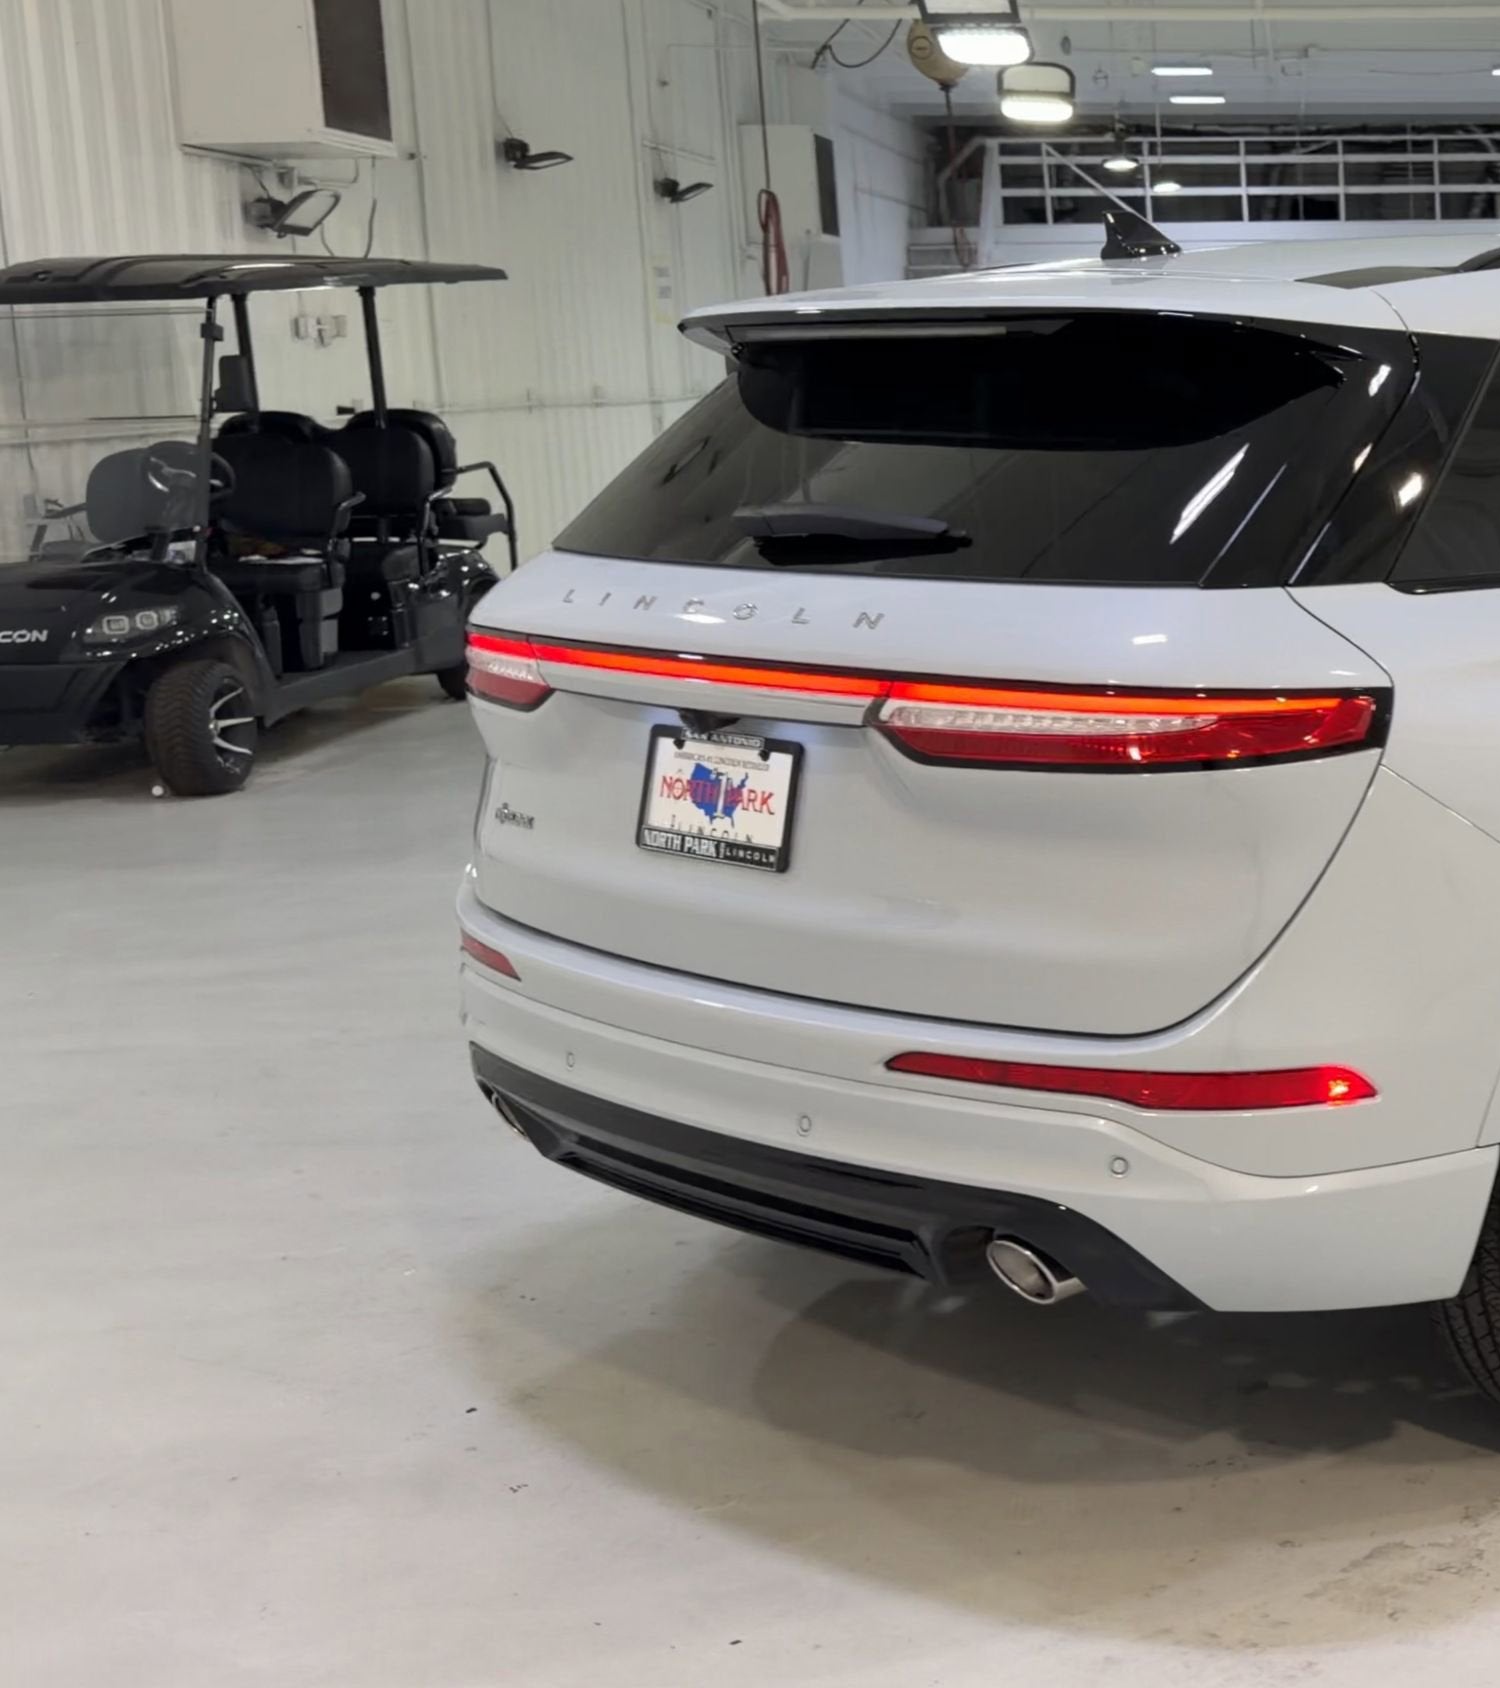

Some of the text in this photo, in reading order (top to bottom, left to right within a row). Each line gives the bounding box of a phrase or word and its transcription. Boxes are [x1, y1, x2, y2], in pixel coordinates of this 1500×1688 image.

[563, 588, 885, 630] LINCOLN
[710, 733, 762, 748] ANTONIO
[660, 775, 775, 815] NORTH PARK
[644, 829, 776, 863] NORTH PARK LINCOLN
